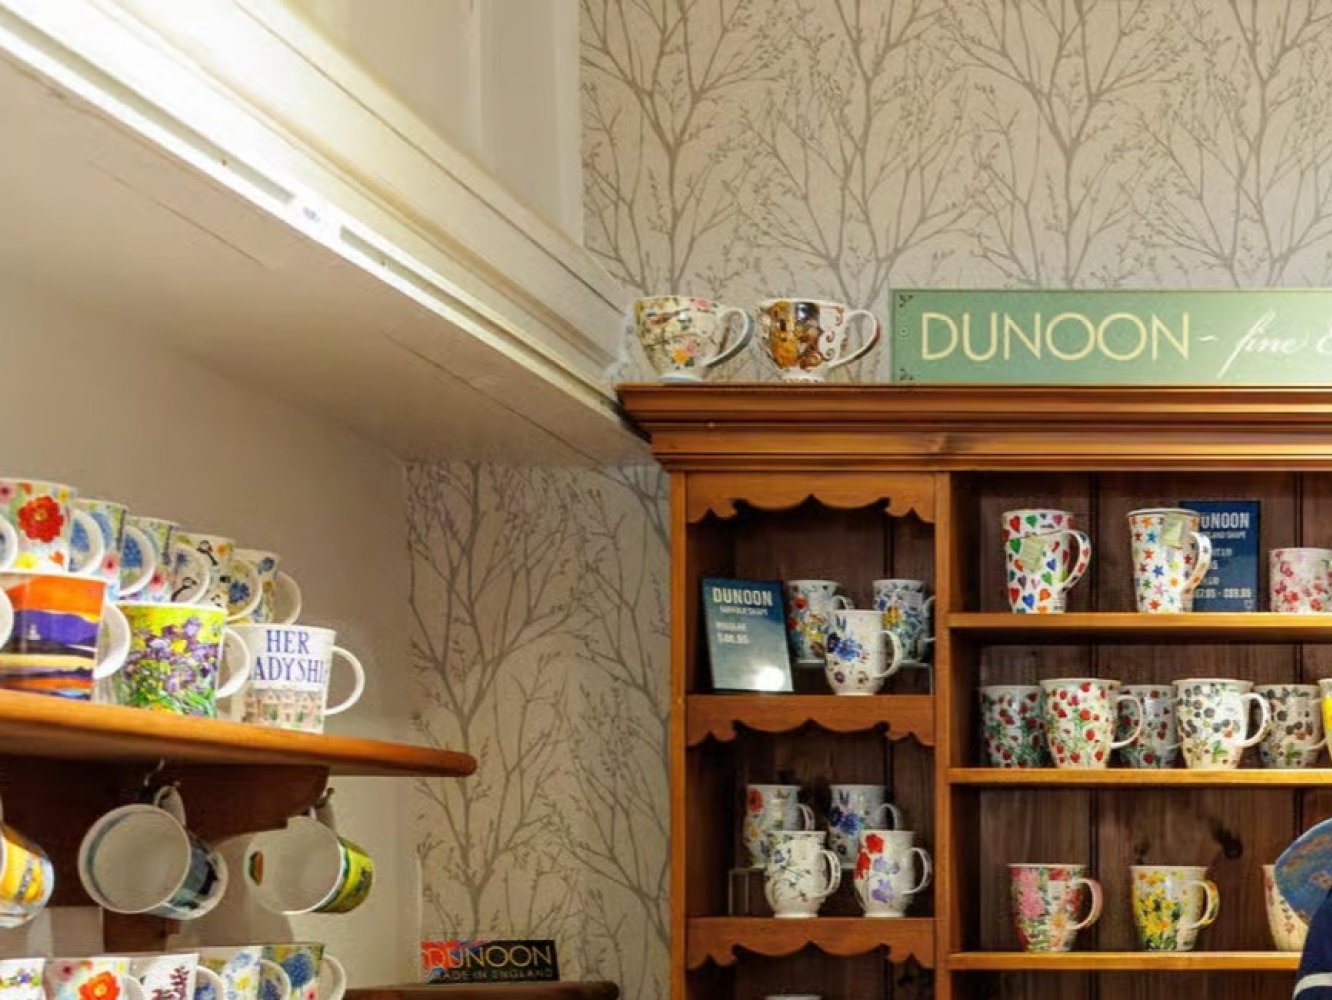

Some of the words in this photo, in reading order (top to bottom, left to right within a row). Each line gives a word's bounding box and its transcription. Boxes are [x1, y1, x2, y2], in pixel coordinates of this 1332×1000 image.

[920, 312, 1189, 361] DUNOON
[1217, 309, 1310, 378] fine
[1200, 512, 1250, 529] UNOON
[712, 587, 773, 607] DUNOON
[266, 629, 310, 654] HER
[250, 656, 327, 684] ADYSHI
[426, 945, 552, 969] DUNOON
